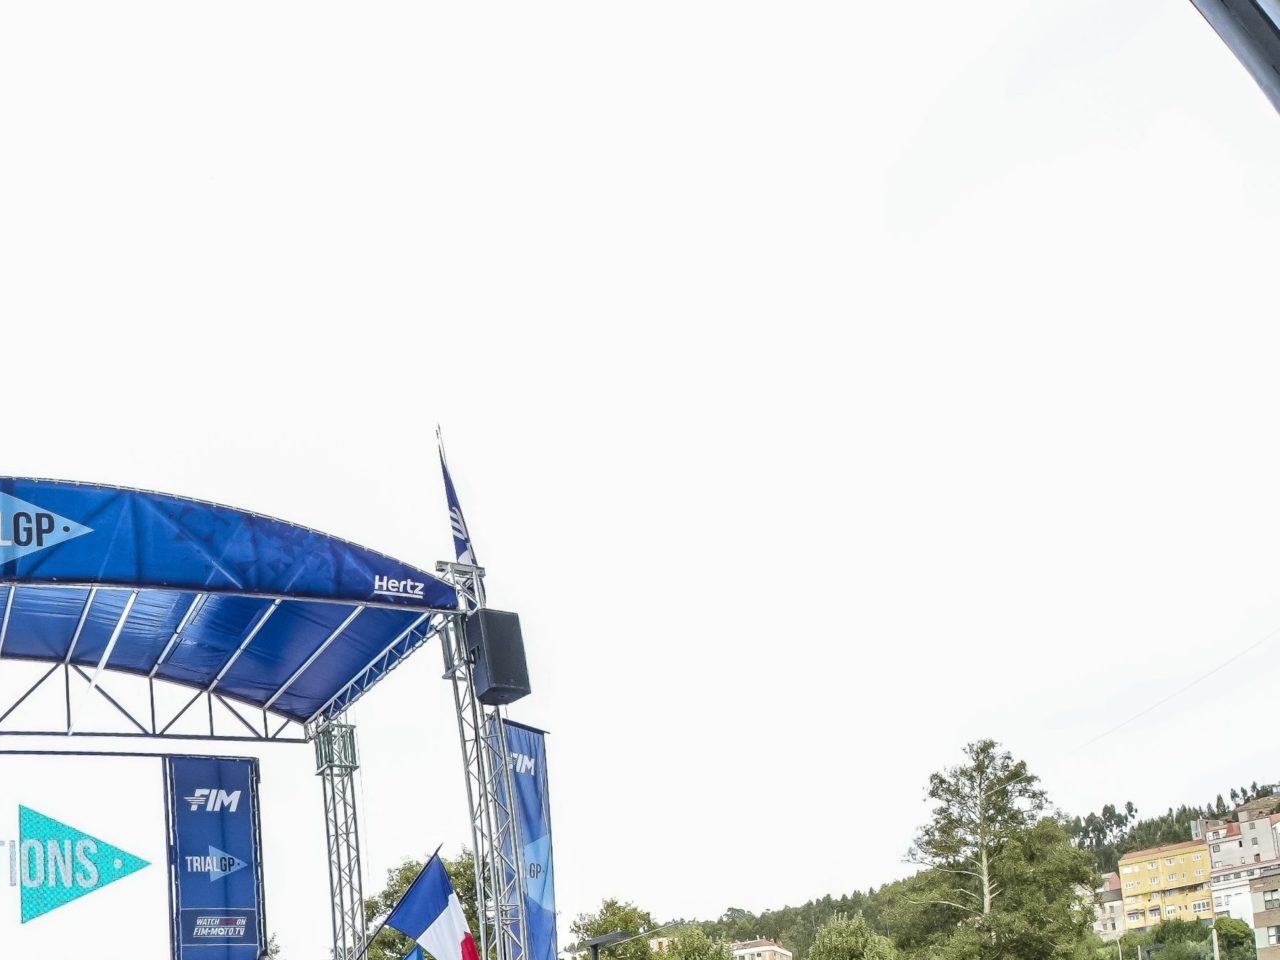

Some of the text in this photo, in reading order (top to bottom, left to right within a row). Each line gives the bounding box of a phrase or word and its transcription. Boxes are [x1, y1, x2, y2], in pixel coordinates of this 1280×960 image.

[373, 574, 425, 596] Hertz
[183, 788, 242, 813] FIM
[185, 856, 236, 874] TRIALGP
[196, 918, 220, 926] WATCH
[236, 918, 247, 926] ON
[193, 927, 246, 937] FIM-MOTO.TV
